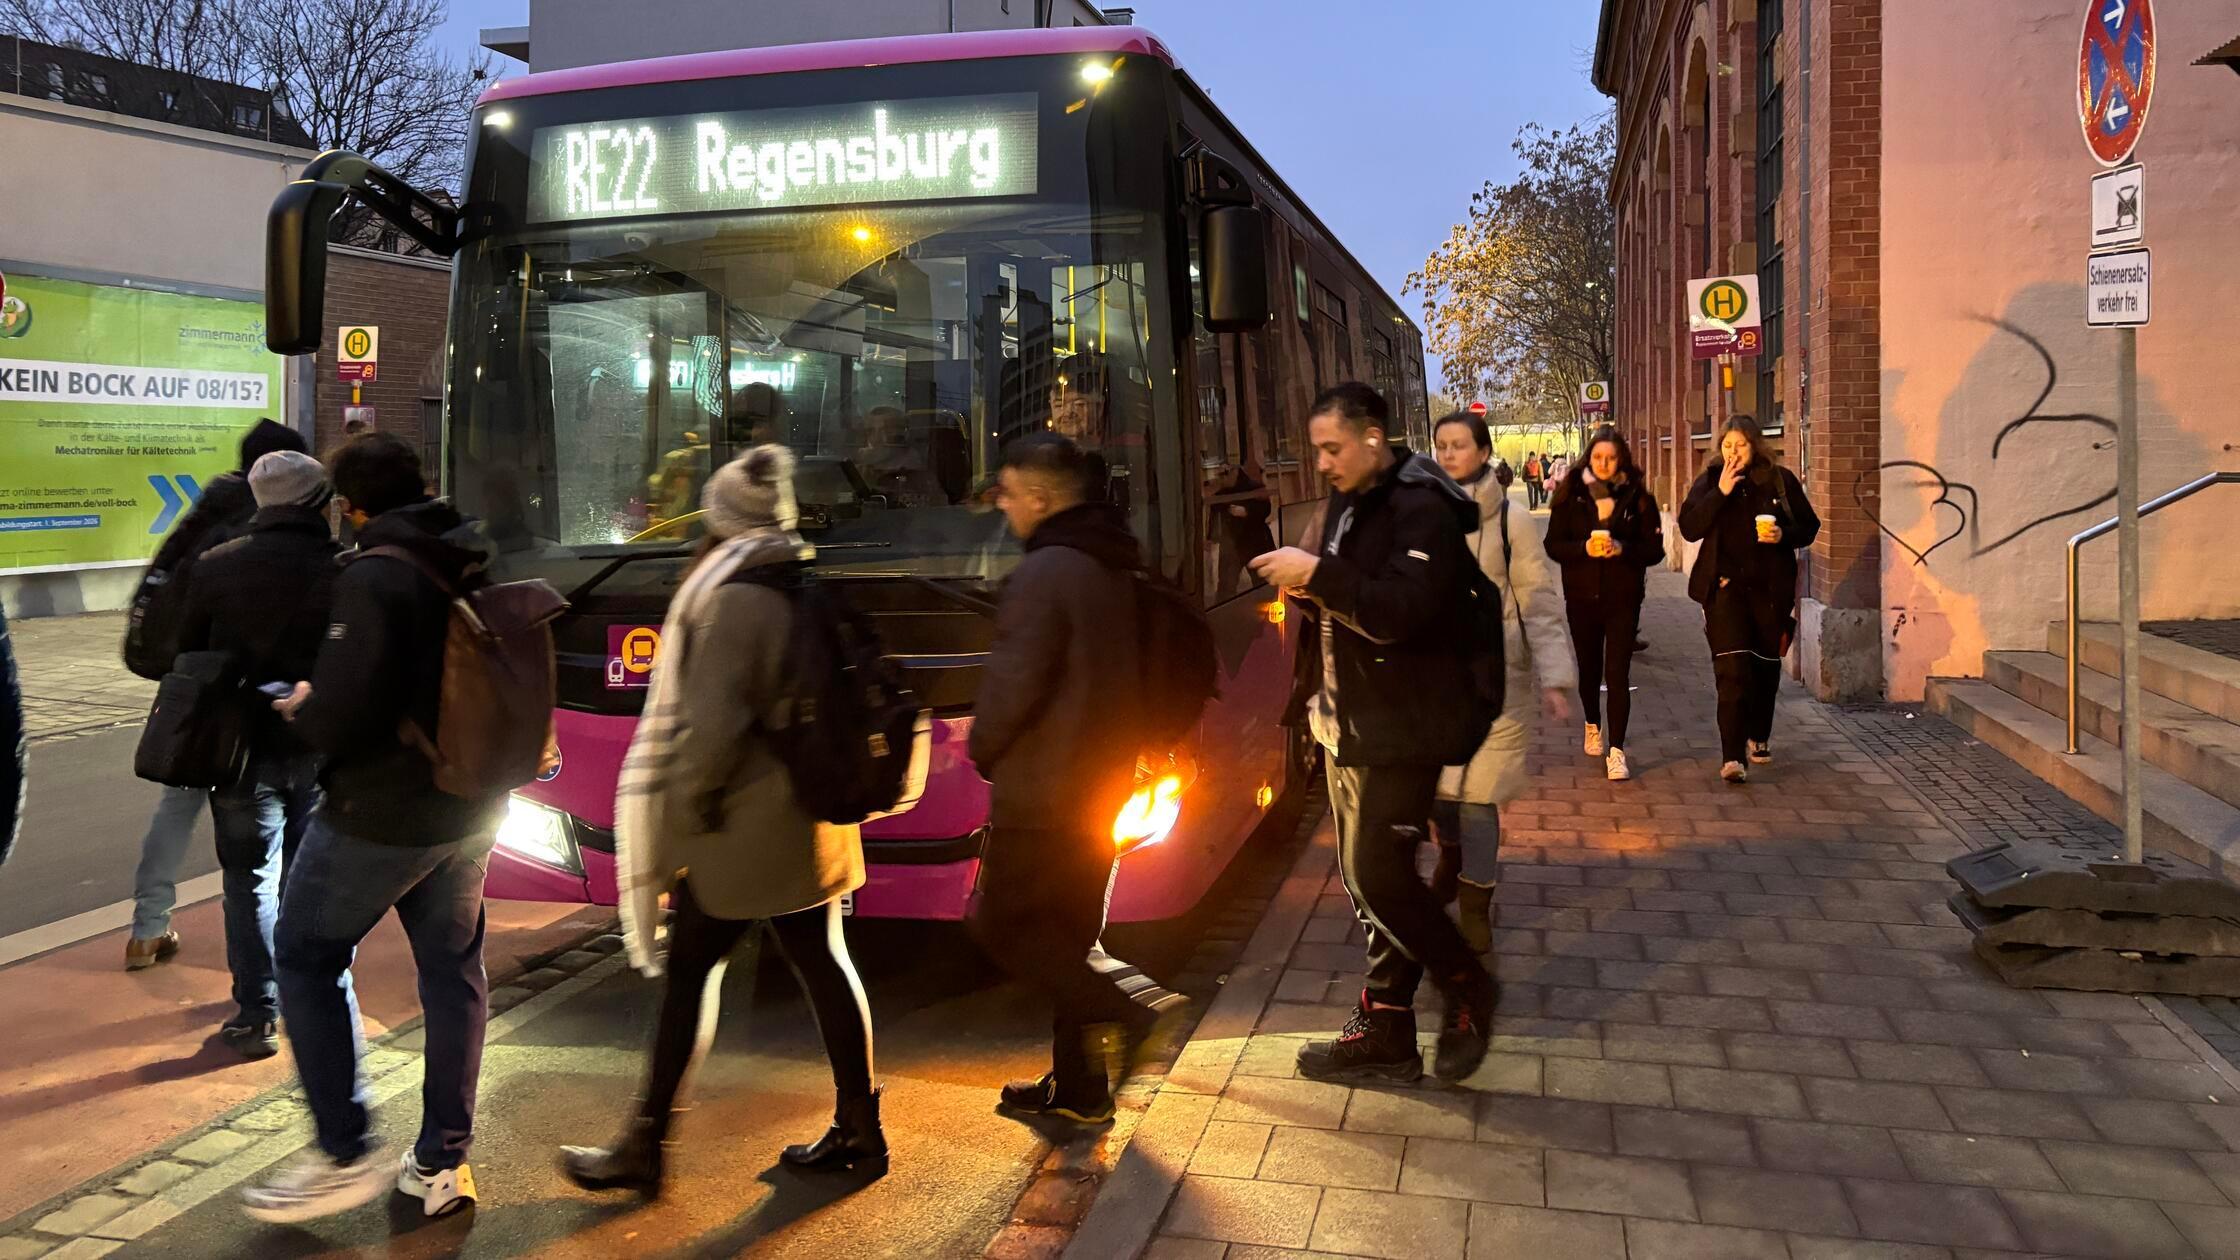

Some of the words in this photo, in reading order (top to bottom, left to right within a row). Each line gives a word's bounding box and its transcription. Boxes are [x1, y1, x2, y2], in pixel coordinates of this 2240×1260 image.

[565, 126, 658, 213] RE22
[697, 107, 1000, 202] Regensburg
[2090, 263, 2147, 285] Schienenersatz-
[1713, 289, 1734, 315] H
[2097, 292, 2124, 312] verkehr
[2125, 290, 2138, 311] frei
[179, 326, 256, 343] zimmermann
[0, 368, 59, 393] KEIN
[68, 372, 136, 397] BOCK
[143, 376, 190, 398] AUF
[196, 378, 264, 401] 08/15?
[55, 445, 124, 455] Mechatroniker
[127, 445, 140, 455] für
[142, 446, 197, 456] Kältetechnik
[13, 487, 41, 496] online
[44, 486, 88, 496] bewerben
